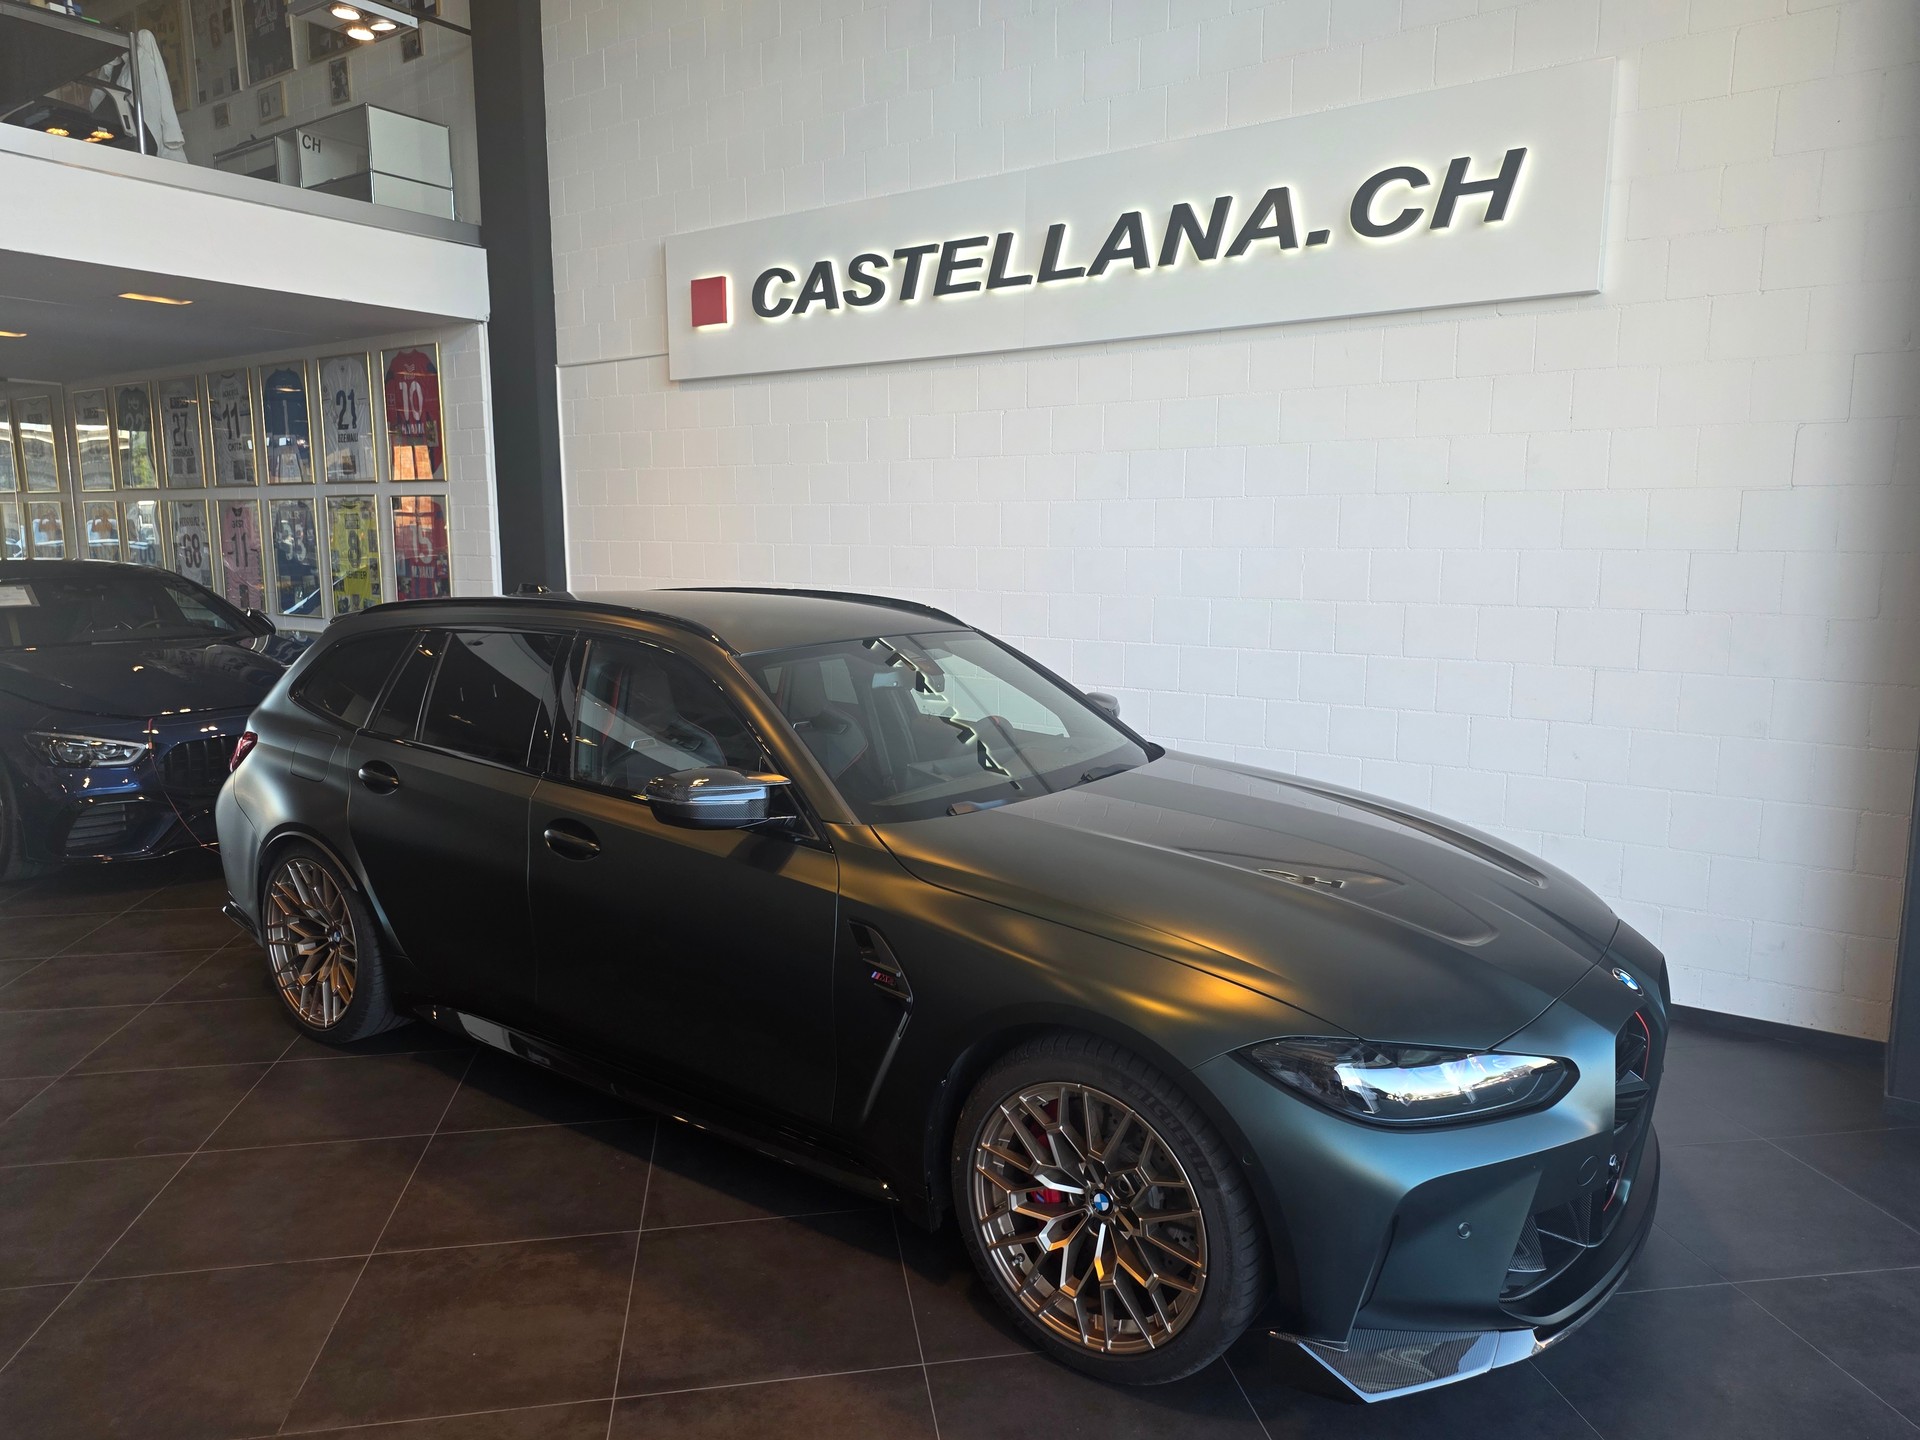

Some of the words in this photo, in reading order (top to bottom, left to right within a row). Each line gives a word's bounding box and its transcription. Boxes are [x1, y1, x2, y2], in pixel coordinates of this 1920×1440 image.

[302, 134, 321, 154] CH
[752, 147, 1528, 319] CASTELLANA.CH
[336, 388, 358, 430] 21
[399, 381, 424, 421] 10
[172, 412, 188, 447] 27
[222, 402, 240, 440] 11
[182, 533, 202, 568] 68
[231, 532, 249, 568] 11
[409, 524, 434, 564] 15
